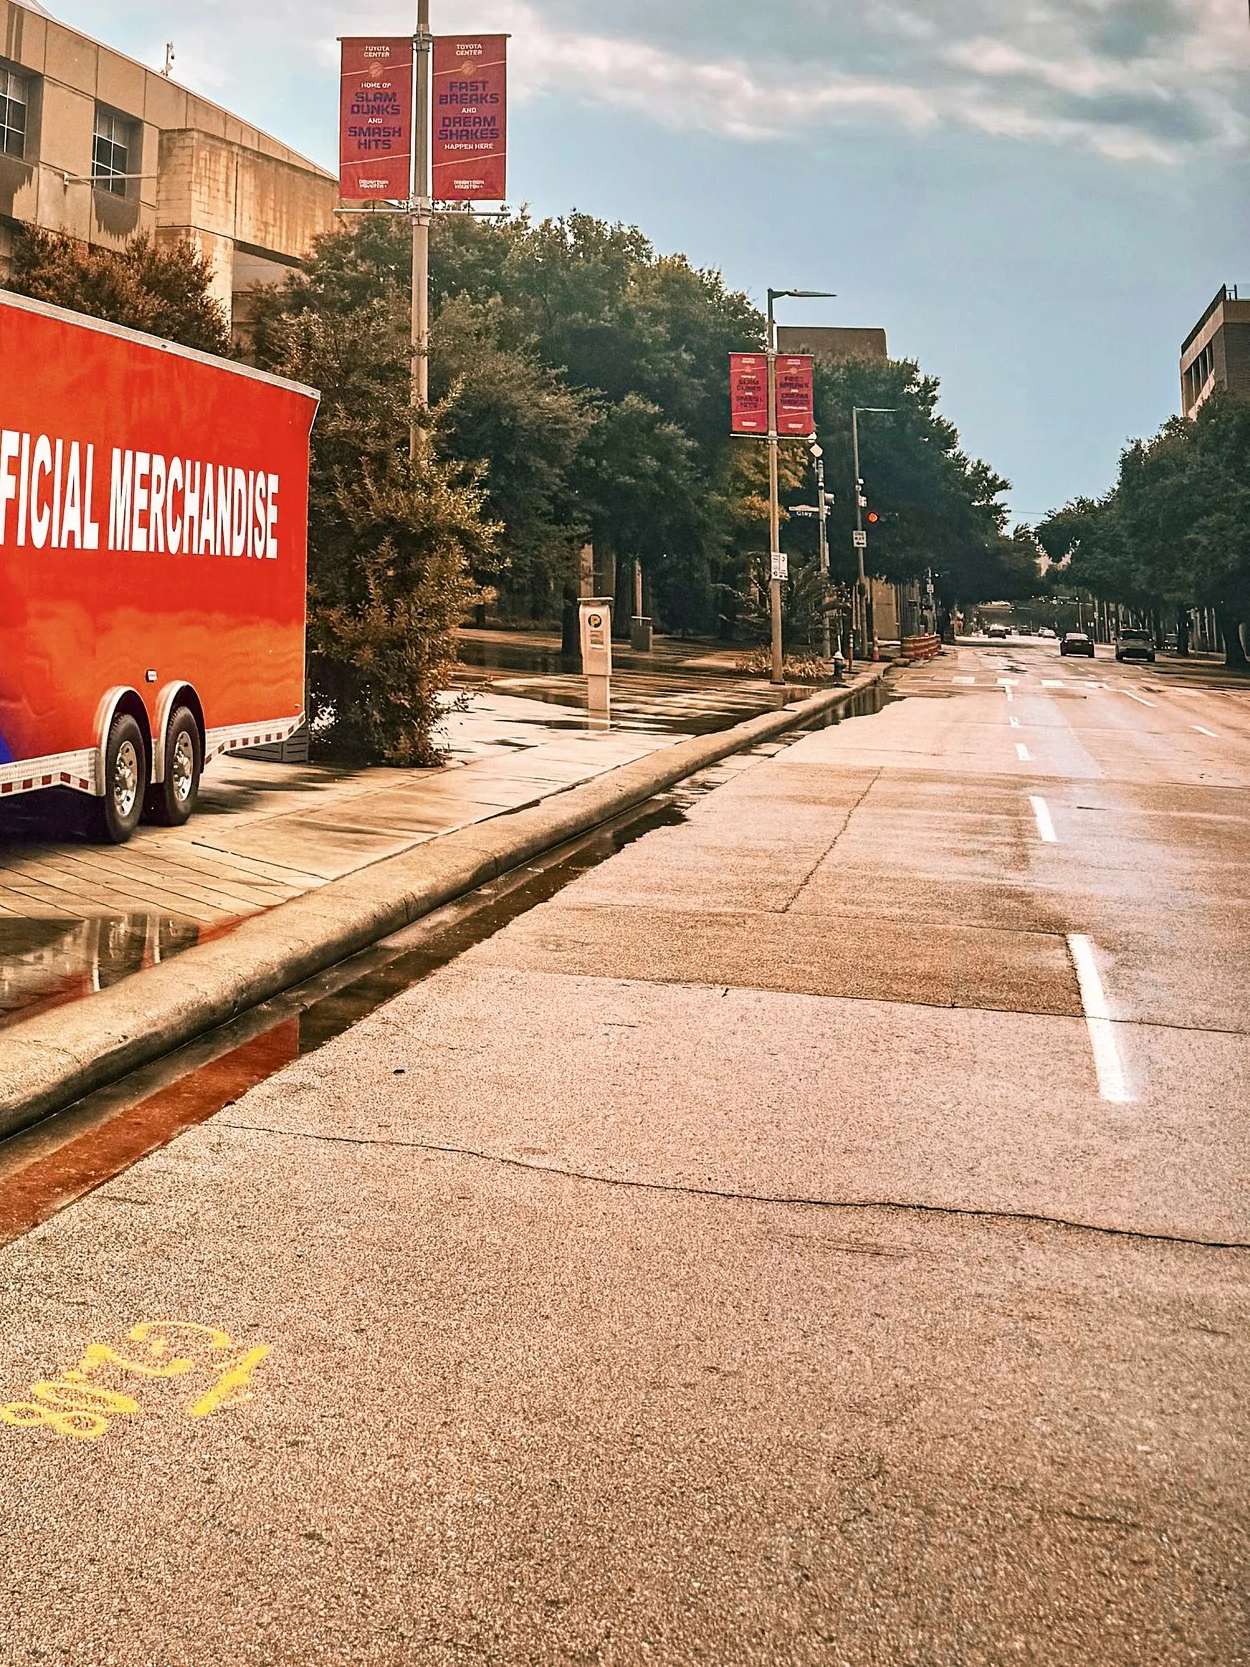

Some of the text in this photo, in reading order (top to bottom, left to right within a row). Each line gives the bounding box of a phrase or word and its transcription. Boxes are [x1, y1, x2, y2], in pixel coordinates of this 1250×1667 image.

[449, 81, 489, 92] FAST
[355, 91, 397, 103] SLAM
[438, 93, 500, 105] BREAKS
[350, 104, 401, 115] DUNKS
[442, 116, 496, 128] DREAM
[347, 126, 402, 138] SMASH
[438, 127, 500, 141] SHAKES
[357, 138, 391, 150] HITS
[474, 142, 494, 150] HERE
[107, 447, 279, 560] MERCHANDISE
